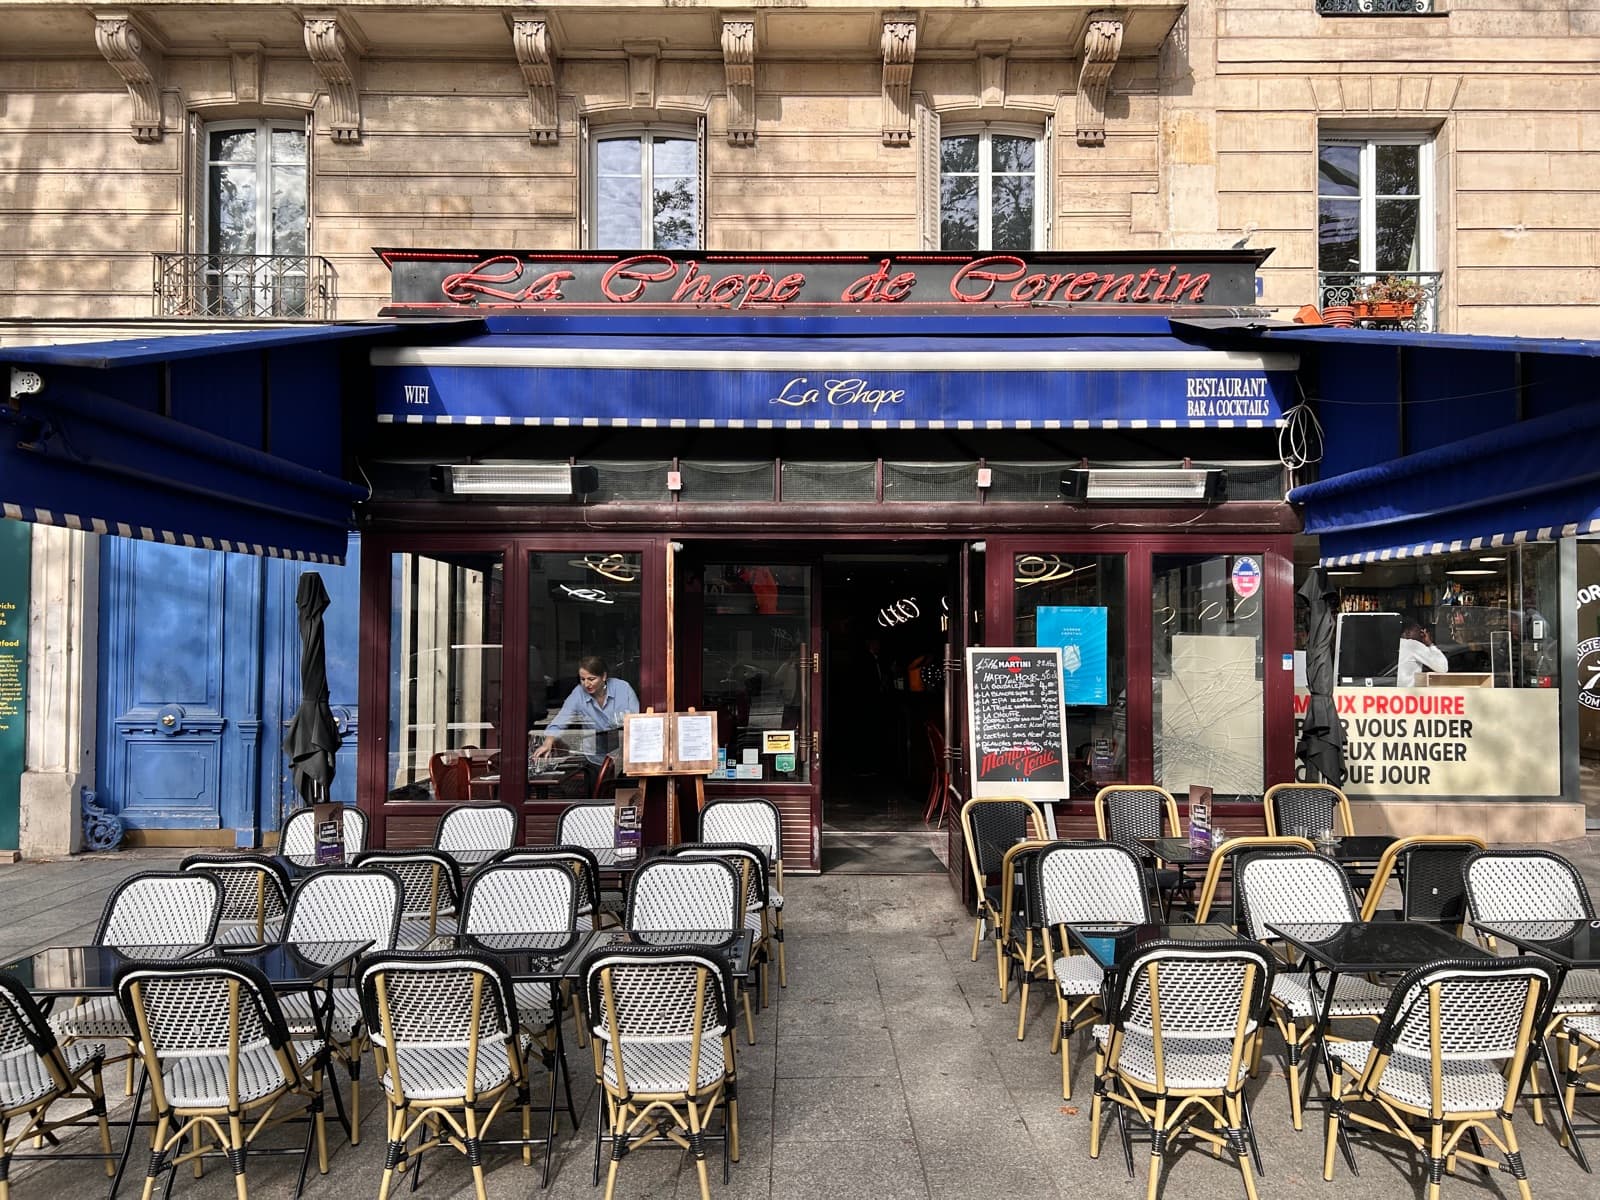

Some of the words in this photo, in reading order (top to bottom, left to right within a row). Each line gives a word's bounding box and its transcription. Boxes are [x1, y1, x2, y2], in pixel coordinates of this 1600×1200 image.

[441, 255, 575, 300] La
[601, 254, 806, 309] Chope
[842, 259, 916, 302] de
[950, 256, 1212, 302] Corentin
[404, 385, 430, 404] WIFI
[769, 377, 820, 406] La
[824, 378, 905, 413] Chope
[1186, 377, 1268, 397] RESTAURANT
[1187, 400, 1207, 416] BAR
[1208, 400, 1215, 416] A
[1216, 400, 1269, 416] COCKTAILS
[983, 672, 1010, 686] HAPPY
[1015, 672, 1040, 682] HOUR
[1363, 695, 1465, 715] PRODUIRE
[1355, 718, 1407, 738] VOUS
[1413, 718, 1473, 738] AIDER
[1382, 742, 1468, 762] MANGER
[1380, 765, 1431, 785] JOUR
